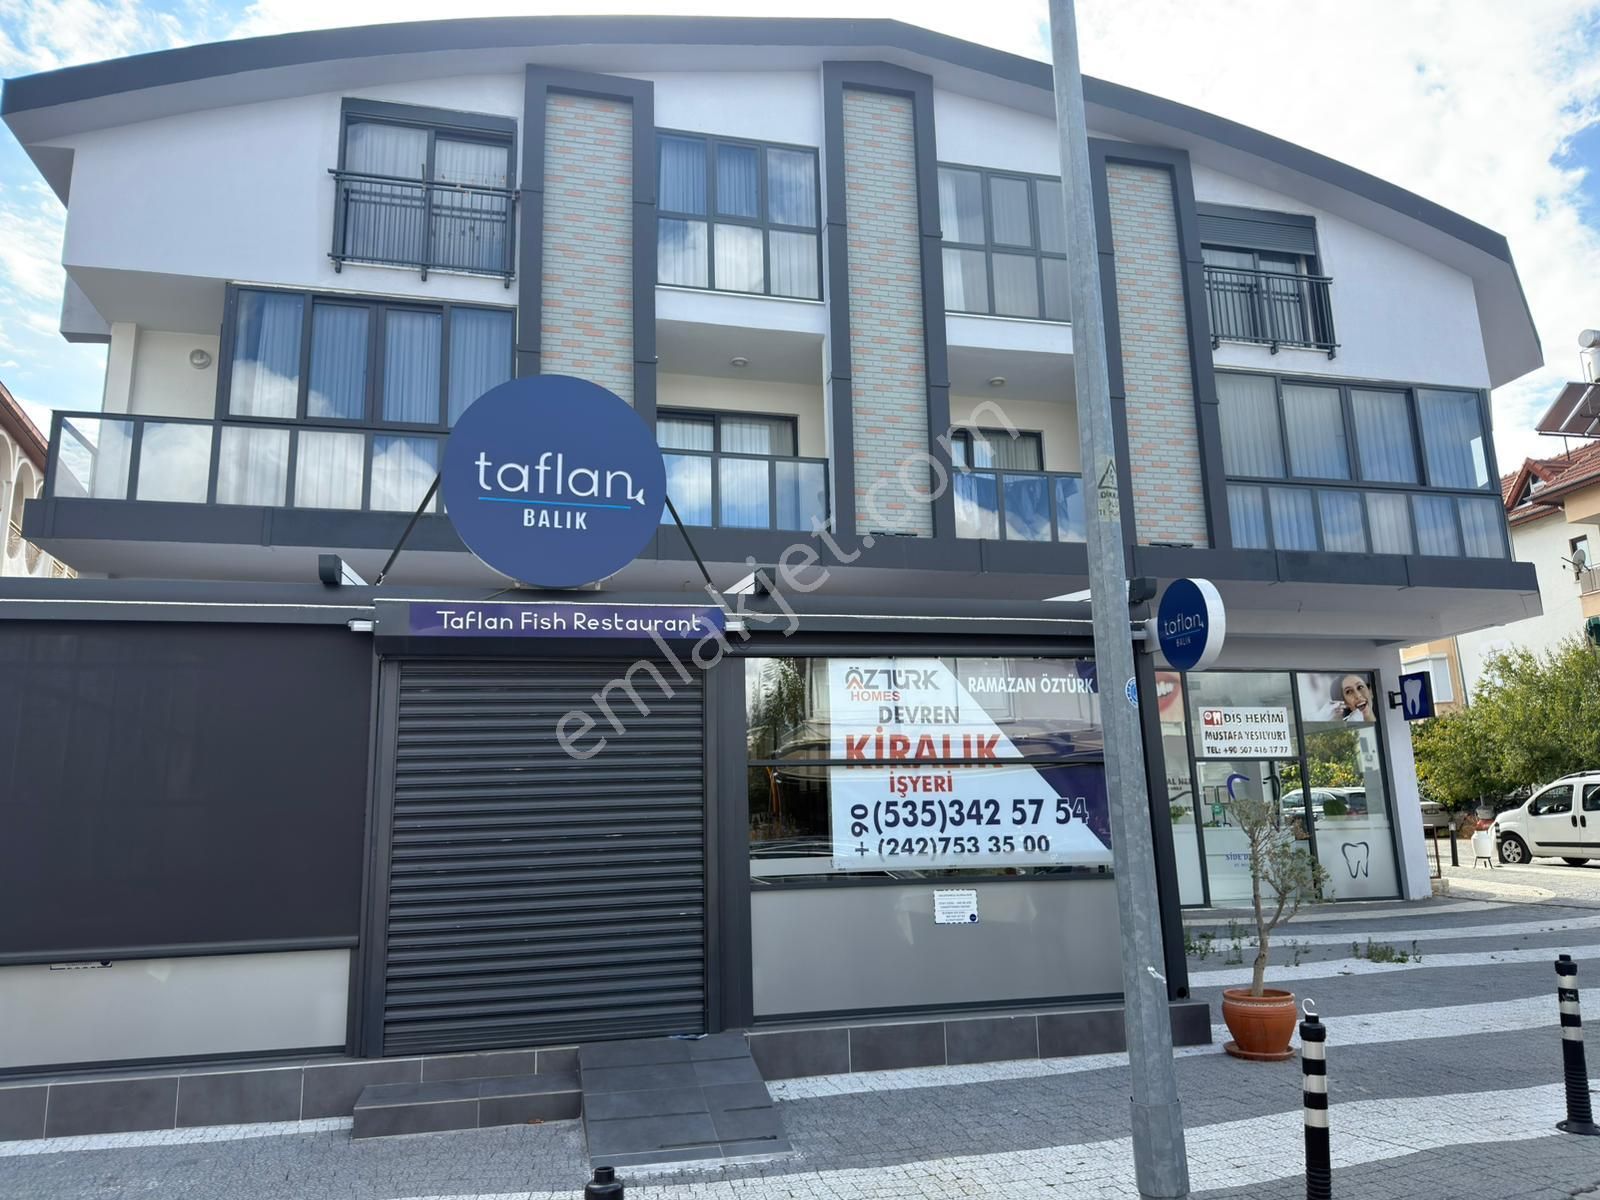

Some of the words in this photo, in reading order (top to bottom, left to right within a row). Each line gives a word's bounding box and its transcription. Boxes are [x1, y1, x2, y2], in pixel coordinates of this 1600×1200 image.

[474, 451, 646, 506] taflan
[522, 508, 588, 530] BALIK
[436, 610, 514, 631] Taflan
[519, 611, 567, 631] Fish
[573, 612, 702, 632] Restaurant
[1164, 613, 1204, 636] taflan
[844, 666, 940, 690] ÖZTÜRK
[967, 676, 1036, 694] RAMAZAN
[1040, 673, 1094, 694] ÖZTÜRK
[850, 691, 901, 702] HOMES
[878, 705, 960, 725] DEVREN
[1204, 730, 1244, 741] MUSTAFA
[844, 725, 1004, 770] KİRALIK
[888, 770, 953, 798] İŞYERİ
[1011, 799, 1044, 825] 57
[1055, 796, 1089, 824] 54
[988, 835, 1016, 854] 35
[1022, 834, 1051, 854] 00
